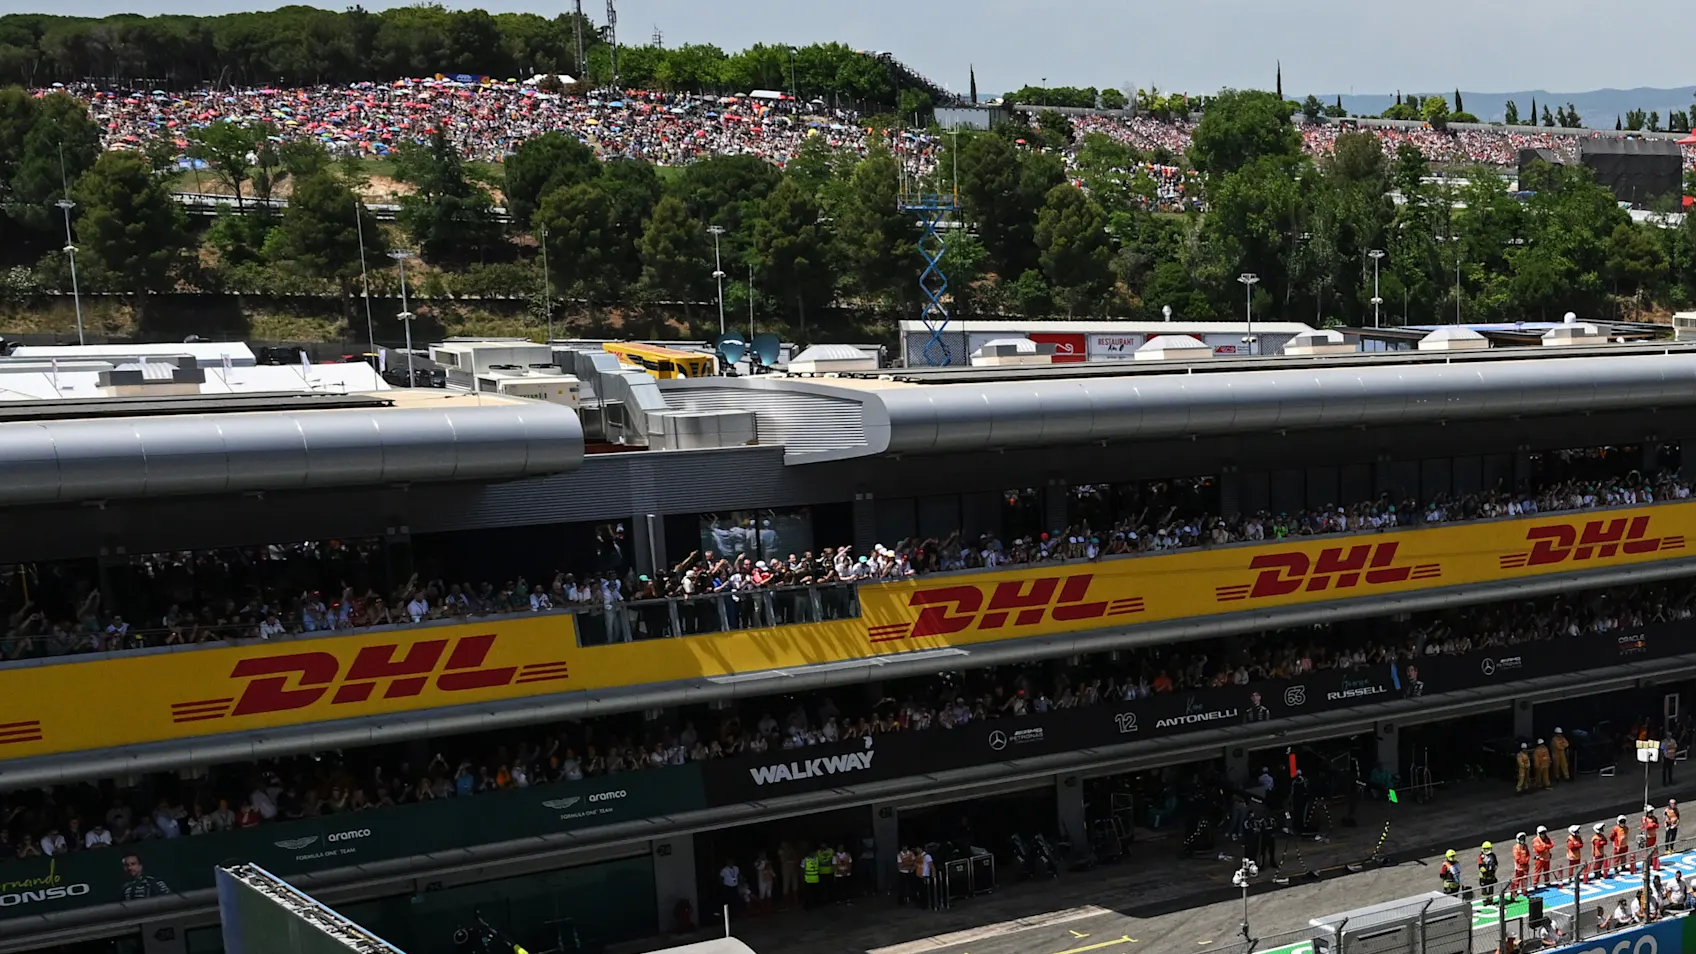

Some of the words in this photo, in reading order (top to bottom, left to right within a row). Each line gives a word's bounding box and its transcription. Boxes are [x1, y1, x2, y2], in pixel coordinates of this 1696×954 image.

[1526, 516, 1662, 567] DHL
[1249, 541, 1412, 598] DHL
[909, 574, 1108, 637] DHL
[230, 634, 518, 716] DHL
[1327, 685, 1387, 701] RUSSELL
[1115, 711, 1139, 735] 12
[1155, 708, 1238, 729] ANTONELLI
[750, 750, 874, 786] WALKWAY
[589, 789, 627, 803] aramco
[328, 828, 371, 842] aramco
[296, 852, 322, 861] FORMULA
